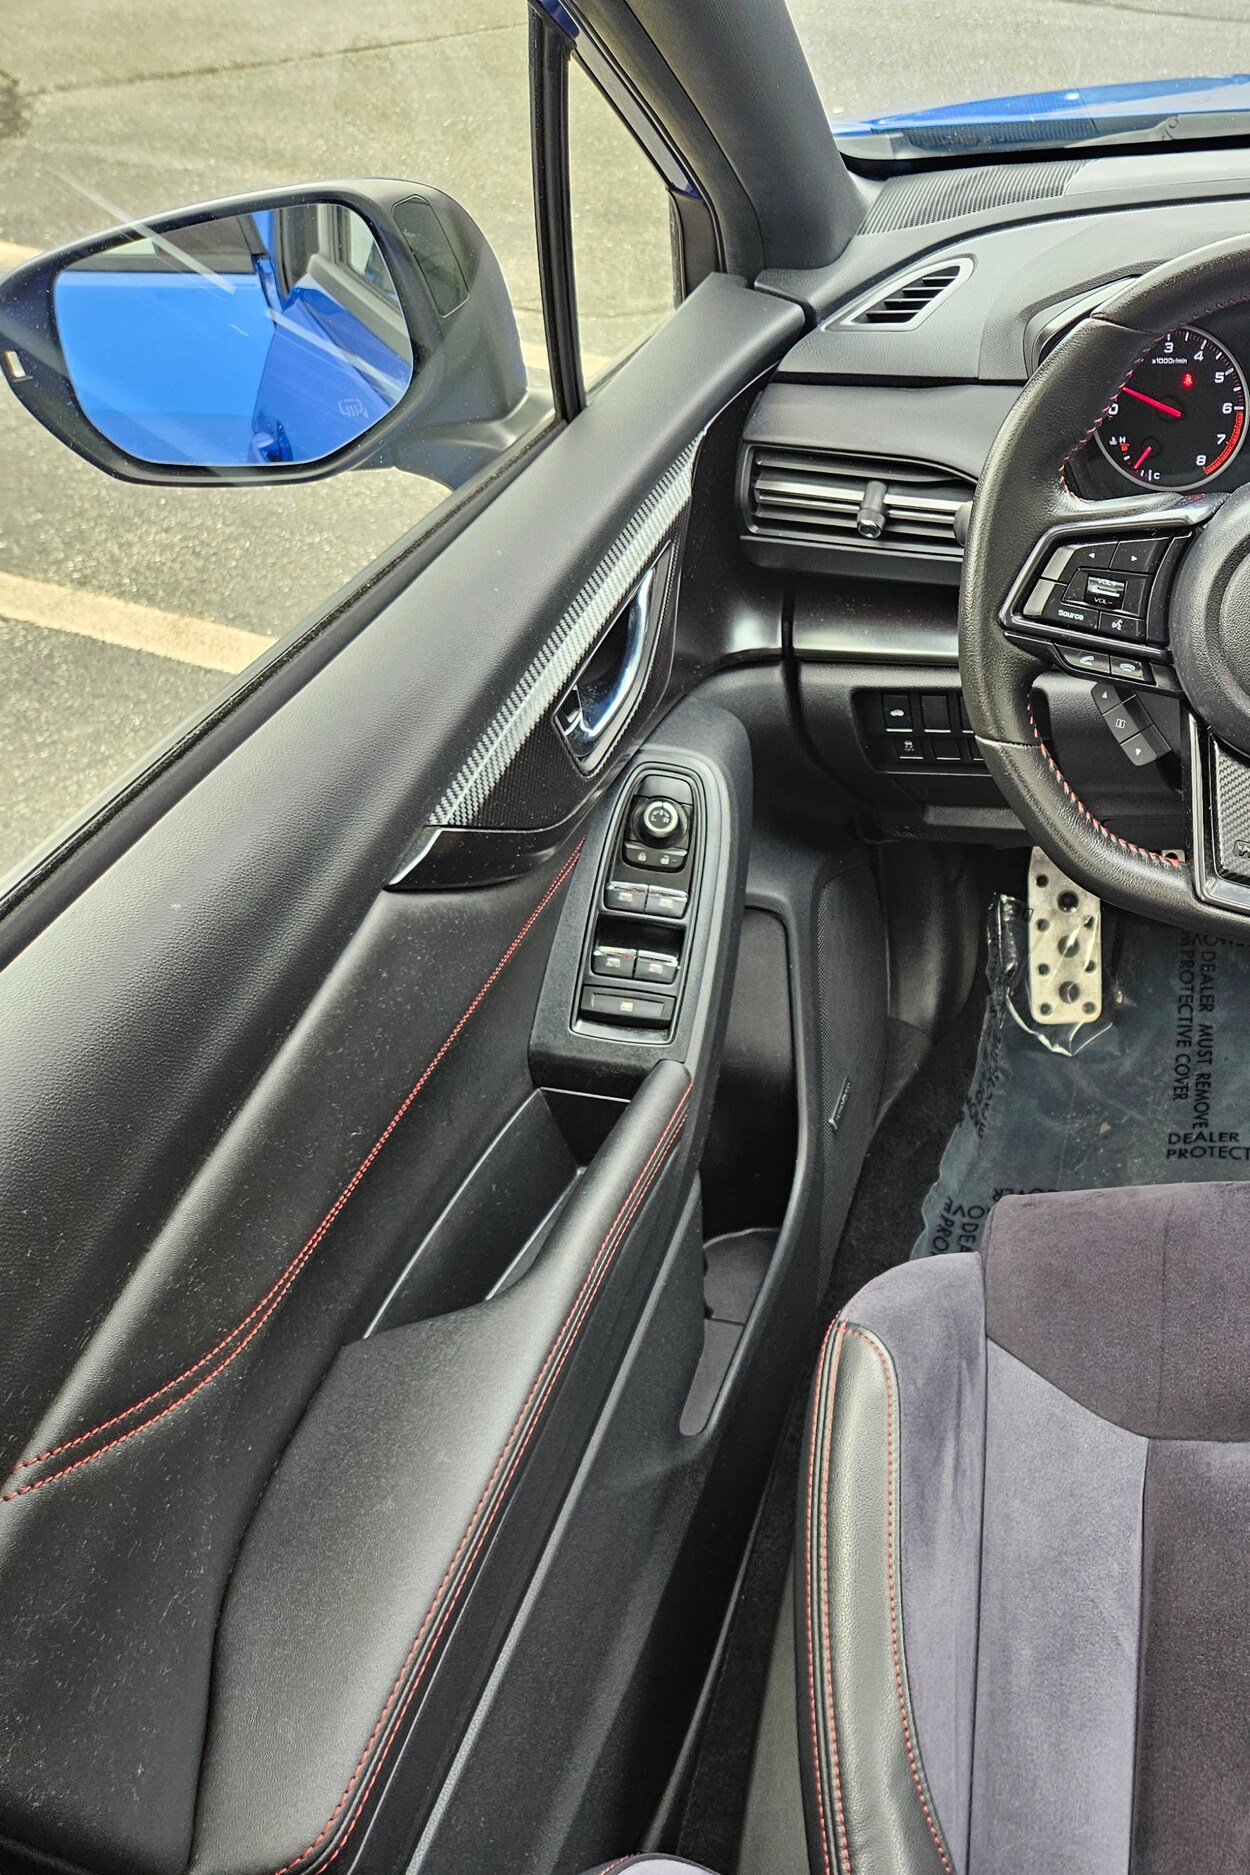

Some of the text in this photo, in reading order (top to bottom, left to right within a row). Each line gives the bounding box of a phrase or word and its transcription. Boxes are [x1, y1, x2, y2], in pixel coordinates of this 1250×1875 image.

[1164, 342, 1174, 353] 3
[1194, 351, 1204, 361] 4
[1214, 372, 1224, 383] 5
[1222, 403, 1232, 414] 6
[1217, 434, 1226, 445] 7
[1196, 455, 1206, 465] 8
[1058, 610, 1084, 620] Source
[1173, 951, 1195, 1101] PROTECTIVE COVER
[1192, 950, 1216, 1130] DEALER MUST REMOVE
[1168, 1132, 1240, 1146] DEALER
